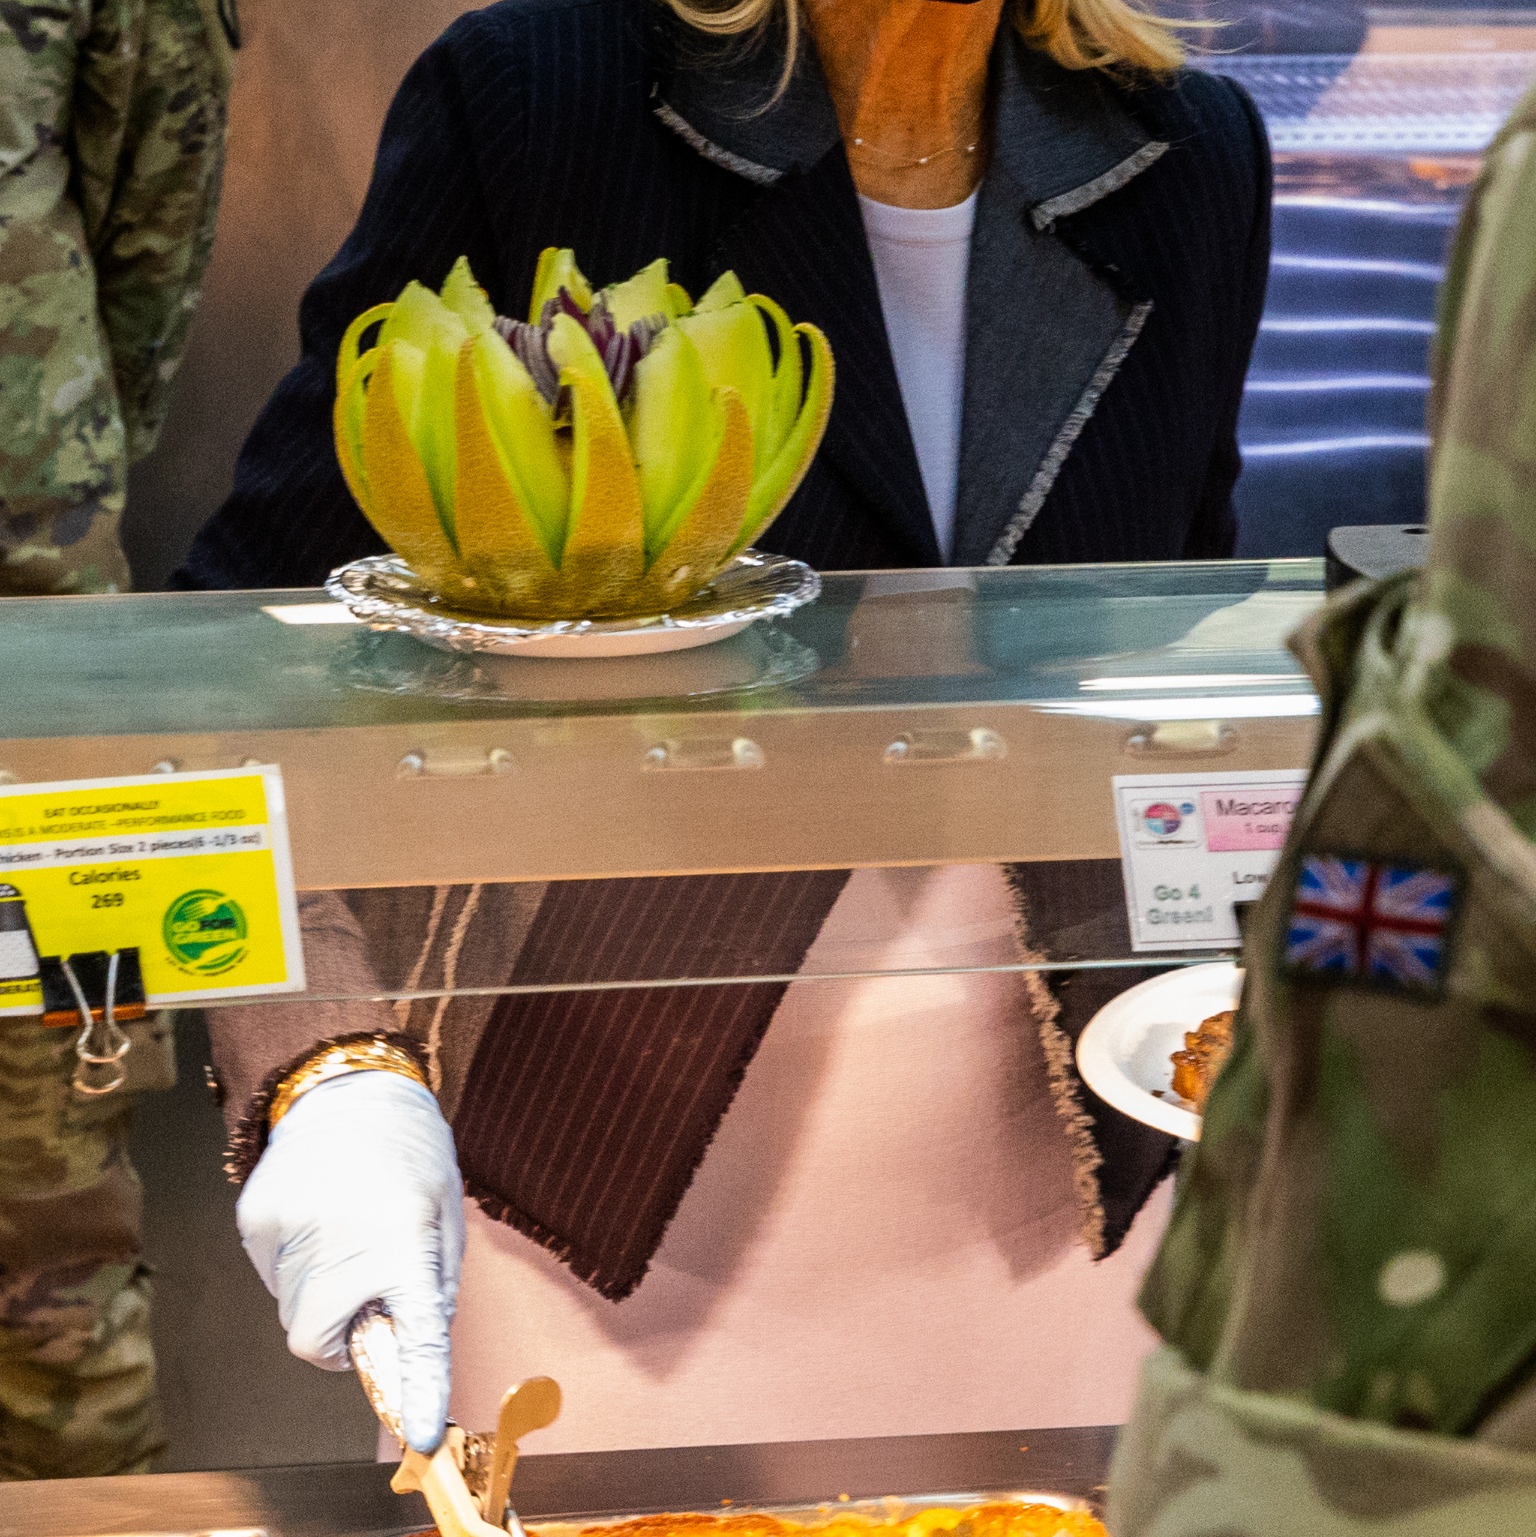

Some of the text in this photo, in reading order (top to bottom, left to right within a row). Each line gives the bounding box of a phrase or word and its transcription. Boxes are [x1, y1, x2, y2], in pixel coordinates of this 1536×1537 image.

[54, 847, 103, 860] Portion
[68, 867, 142, 886] Calories
[1154, 883, 1201, 900] Go 4
[91, 893, 124, 909] 269
